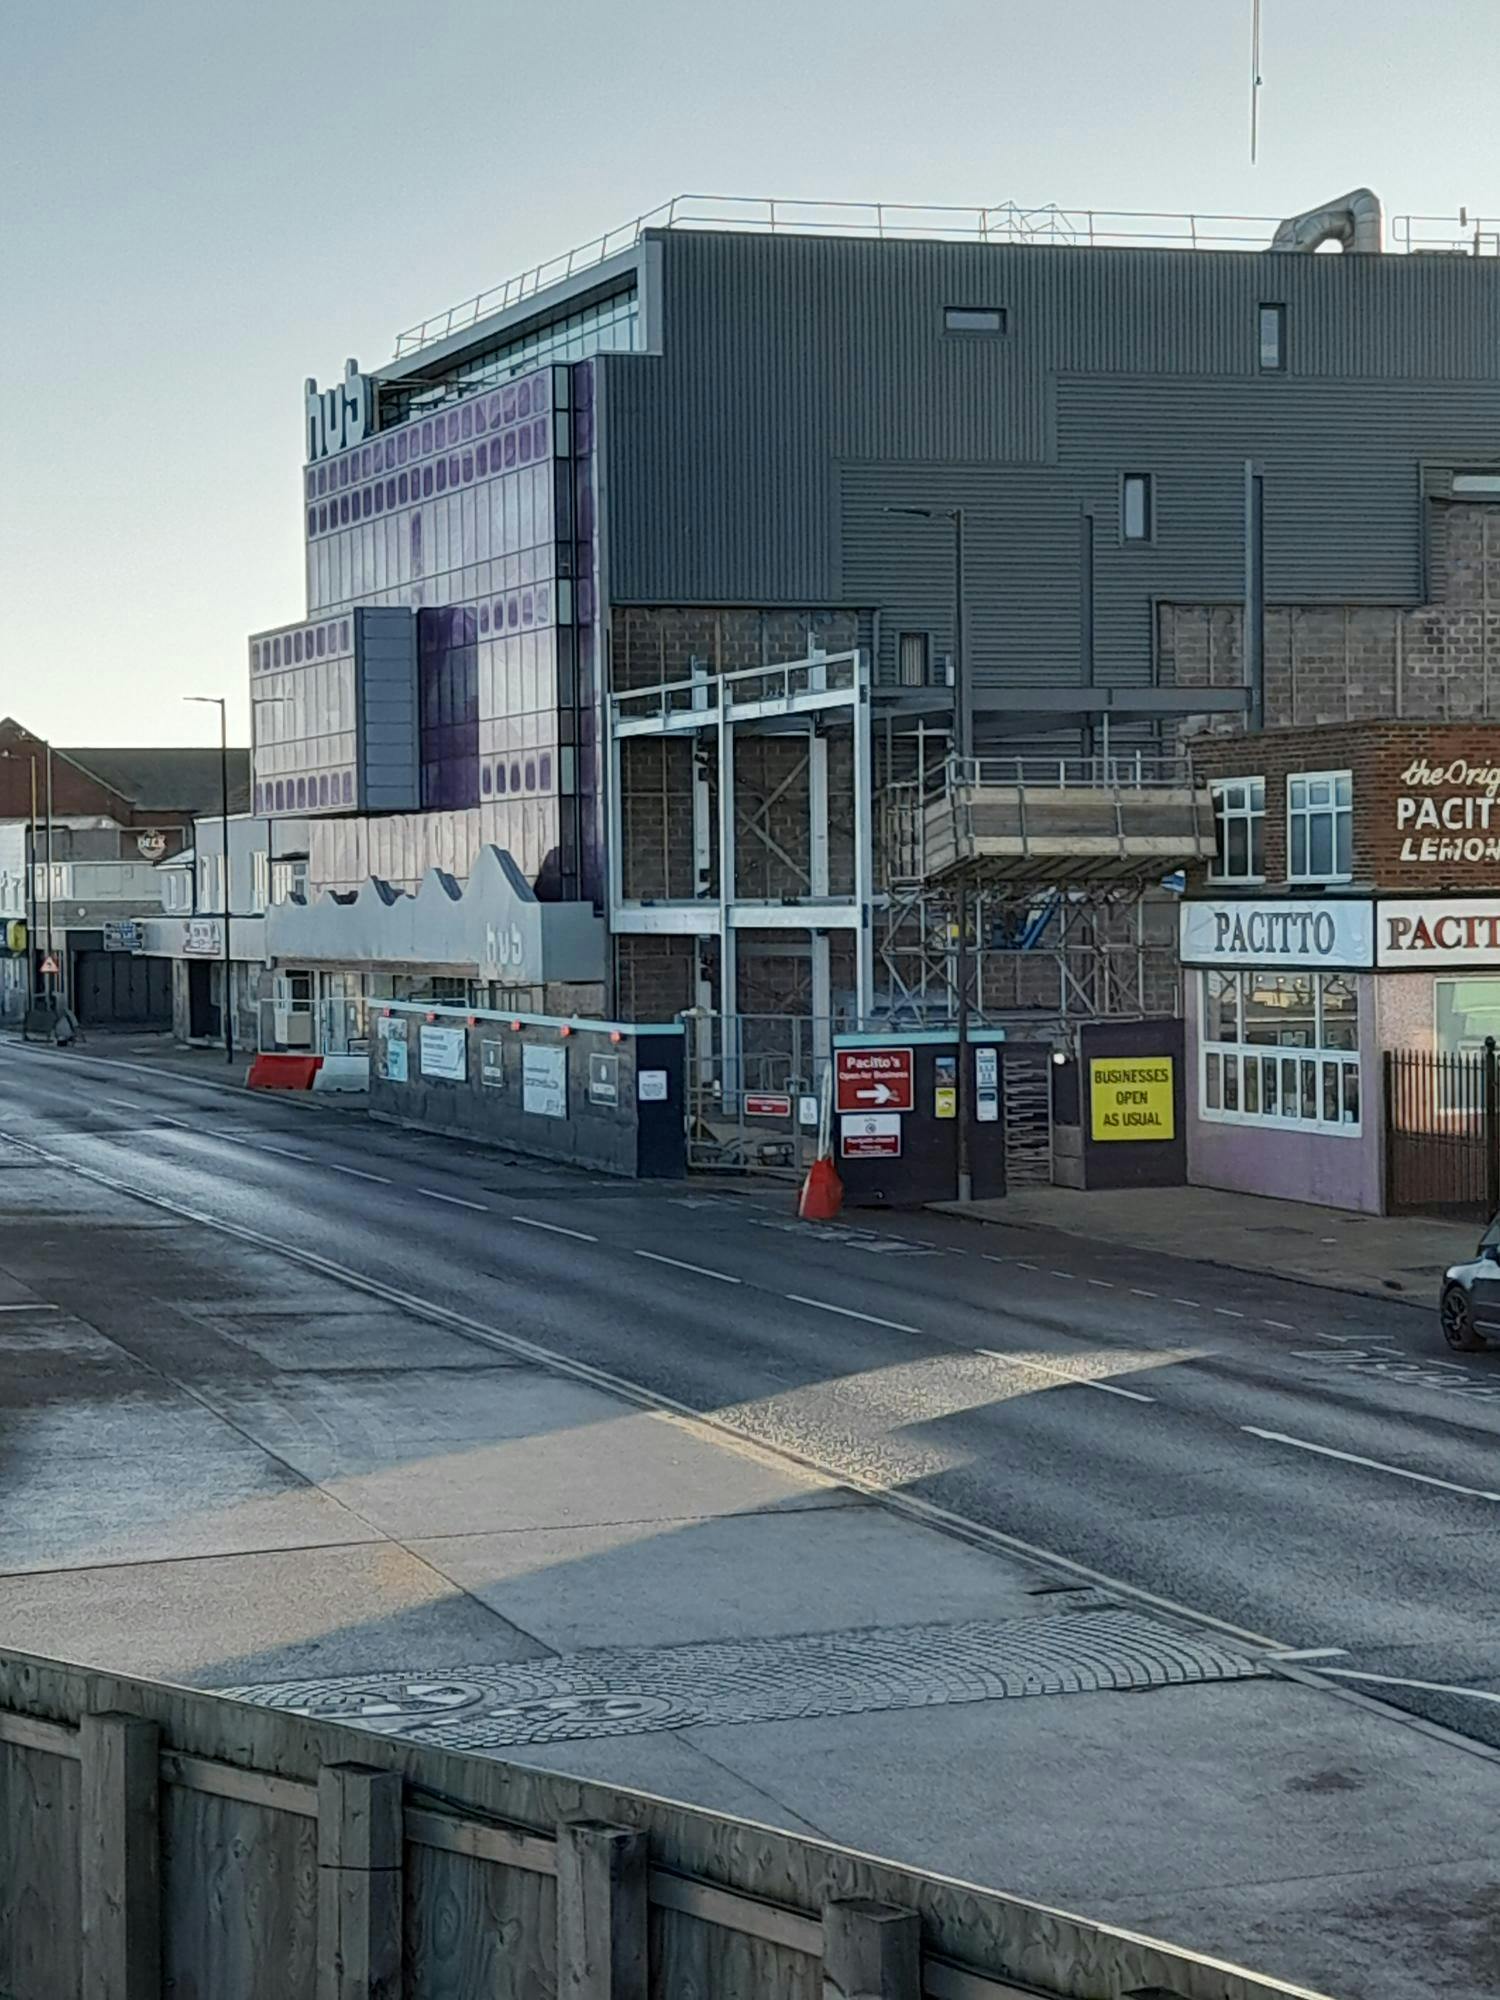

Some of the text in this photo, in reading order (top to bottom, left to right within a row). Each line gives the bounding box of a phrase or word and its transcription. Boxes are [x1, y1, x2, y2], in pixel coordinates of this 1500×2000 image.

[304, 358, 367, 461] hub
[1401, 759, 1443, 785] the
[1397, 797, 1500, 830] PACIT
[1214, 911, 1335, 954] PACITTO
[1095, 1069, 1169, 1083] BUSINESSES
[1116, 1091, 1148, 1105] OPEN
[1103, 1112, 1162, 1126] AS USUAL
